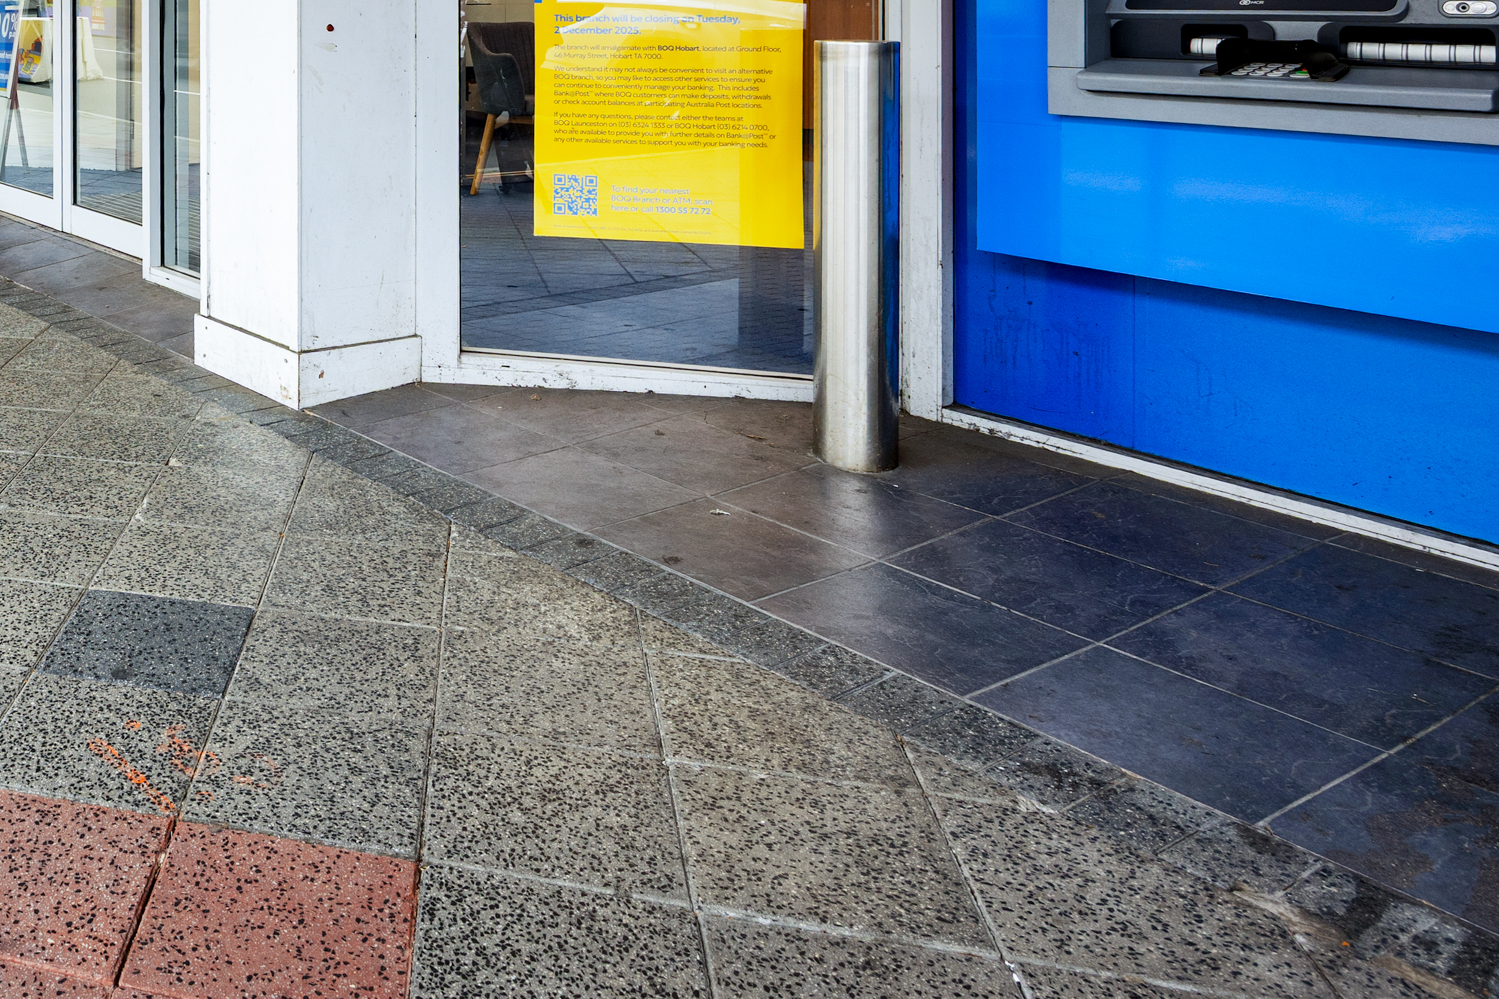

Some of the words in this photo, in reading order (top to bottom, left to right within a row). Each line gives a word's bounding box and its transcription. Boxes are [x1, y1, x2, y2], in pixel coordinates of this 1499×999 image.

[554, 14, 573, 22] This
[575, 14, 610, 22] branch
[612, 15, 628, 23] will
[630, 15, 643, 23] be
[644, 15, 679, 25] closing
[696, 15, 741, 25] Tuesday,
[554, 26, 560, 34] 2
[562, 26, 612, 34] December
[615, 27, 641, 35] 2025.
[611, 185, 620, 193] To
[622, 185, 638, 193] find
[640, 187, 658, 195] your
[633, 196, 660, 204] Branch
[673, 197, 692, 205] ATM,
[611, 204, 628, 212] here
[641, 205, 654, 213] call
[656, 206, 676, 214] 1300
